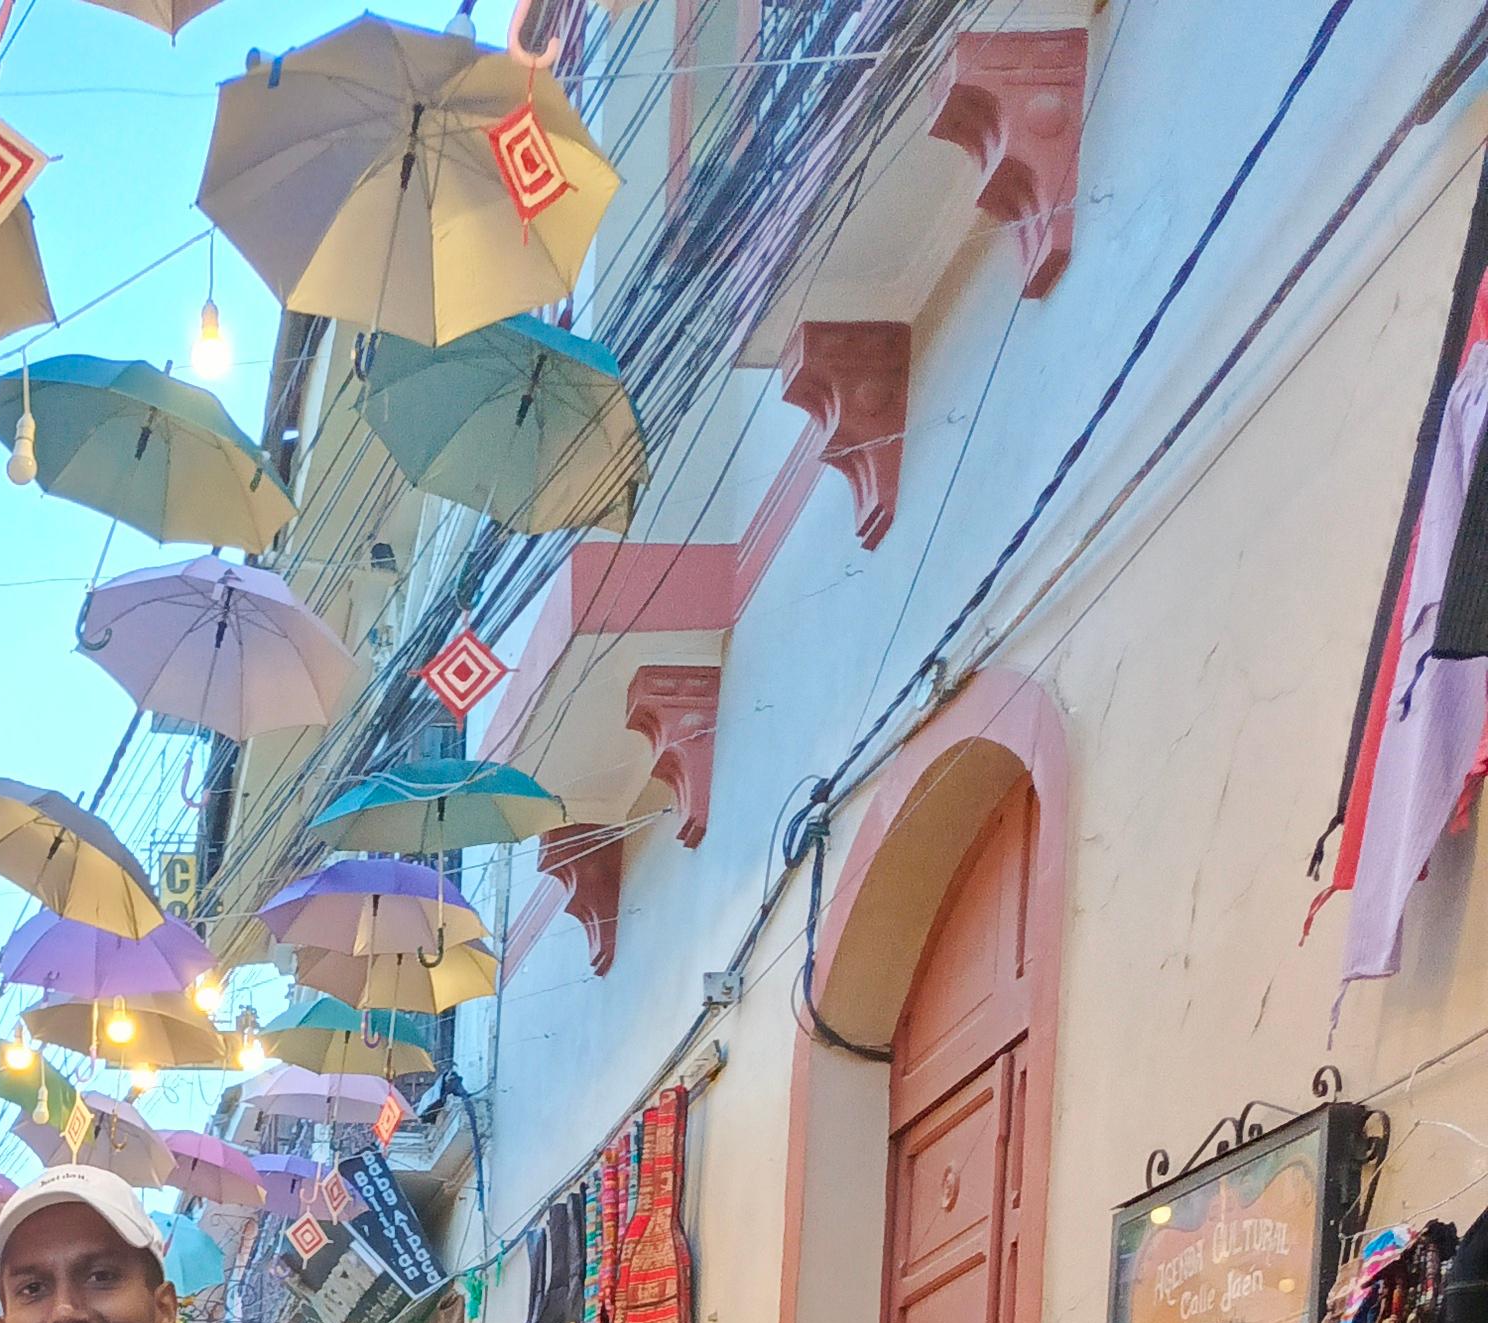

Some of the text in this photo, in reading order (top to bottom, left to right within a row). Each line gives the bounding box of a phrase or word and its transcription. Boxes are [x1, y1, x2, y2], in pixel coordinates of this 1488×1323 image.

[353, 1170, 420, 1281] Bolivian
[362, 1150, 442, 1284] Baby Alpaca
[1155, 1219, 1291, 1305] AGENDA CULTURAL
[1180, 1264, 1265, 1320] Calle Jaén
